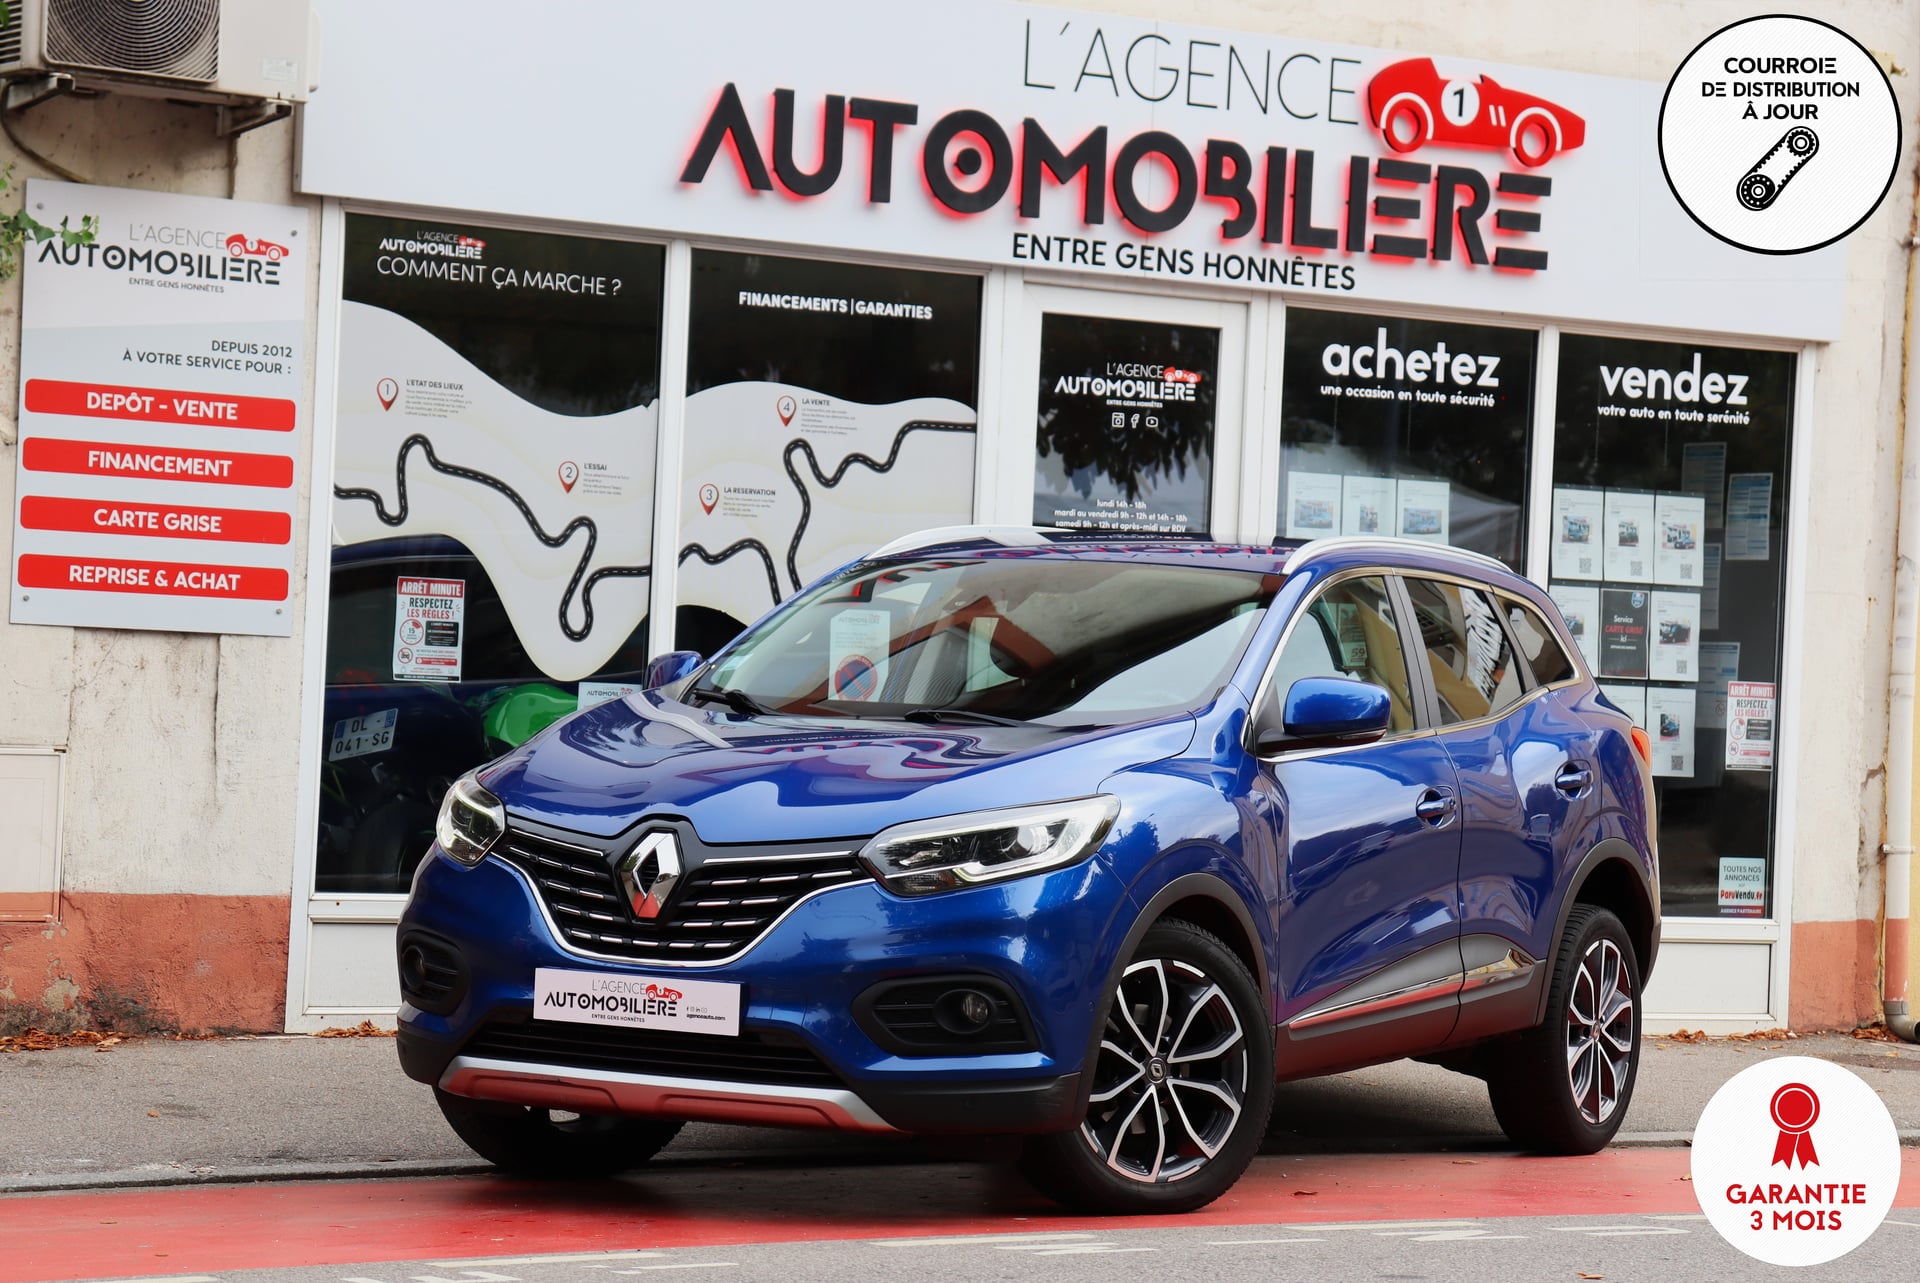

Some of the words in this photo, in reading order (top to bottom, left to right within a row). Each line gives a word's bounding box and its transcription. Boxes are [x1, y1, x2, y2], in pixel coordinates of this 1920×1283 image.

[1024, 19, 1362, 125] L'AGENCE
[129, 223, 227, 250] L'AGENCE
[416, 231, 459, 243] L'AGENCE
[1012, 232, 1107, 267] ENTRE
[1115, 243, 1194, 275] GENS
[1204, 252, 1356, 291] HONNÊTES
[376, 255, 487, 283] COMMENT
[491, 266, 518, 289] ÇA
[523, 270, 606, 295] MARCHE
[611, 278, 622, 295] ?
[128, 277, 156, 288] ENTRE
[157, 280, 180, 290] GENS
[180, 282, 225, 293] HONNÊTES
[739, 291, 848, 313] FINANCEMENTS
[855, 301, 933, 319] GARANTIES
[211, 340, 259, 355] DEPUIS
[262, 344, 293, 358] 2012
[122, 347, 132, 362] À
[136, 350, 182, 366] VOTRE
[186, 354, 241, 371] SERVICE
[245, 360, 282, 374] POUR
[1322, 327, 1500, 387] achetez
[1106, 362, 1164, 379] L'AGENCE
[428, 381, 442, 389] DES
[443, 382, 464, 390] LIEUX
[1600, 352, 1749, 405] vendez
[1320, 385, 1342, 395] une
[1346, 385, 1395, 399] occasion
[1398, 391, 1412, 400] en
[1416, 390, 1446, 403] toute
[1450, 391, 1495, 407] sécurité
[86, 389, 155, 413] DEPÔT
[173, 399, 238, 420] VENTE
[783, 402, 790, 412] 4
[1597, 404, 1626, 416] votre
[1629, 406, 1655, 419] auto
[1658, 410, 1671, 420] en
[1675, 409, 1704, 422] toute
[88, 450, 232, 477] FINANCEMENT
[565, 466, 573, 478] 2
[706, 489, 713, 500] 3
[733, 487, 776, 496] RESERVATION
[1097, 499, 1115, 508] lundi
[1116, 500, 1128, 509] 14h
[93, 507, 159, 530] CARTE
[164, 512, 222, 533] GRISE
[1055, 508, 1076, 517] mardi
[1088, 509, 1119, 519] vendredi
[1136, 511, 1147, 520] 12h
[1149, 512, 1156, 520] et
[1157, 512, 1169, 521] 14h
[1055, 519, 1081, 528] samedi
[1098, 521, 1110, 529] 12h
[1120, 522, 1158, 532] après-midi
[1160, 524, 1171, 532] sur
[1172, 524, 1186, 532] RDV
[69, 564, 151, 587] REPRISE
[154, 569, 169, 588] &
[175, 571, 241, 591] ACHAT
[401, 581, 427, 594] ARRÊT
[430, 582, 461, 596] MINUTE
[409, 597, 453, 609] RESPECTEZ
[407, 608, 420, 618] LES
[1614, 614, 1633, 623] Service
[1731, 684, 1750, 696] ARRÊT
[1737, 699, 1768, 709] RESPECTEZ
[1735, 709, 1744, 717] LES
[351, 718, 367, 733] DL
[1723, 865, 1747, 873] TOUTES
[1748, 866, 1762, 874] NOS
[1724, 874, 1760, 882] ANNONCES
[1720, 889, 1763, 900] ParuVendu.fr
[592, 979, 647, 995] L'AGENCE
